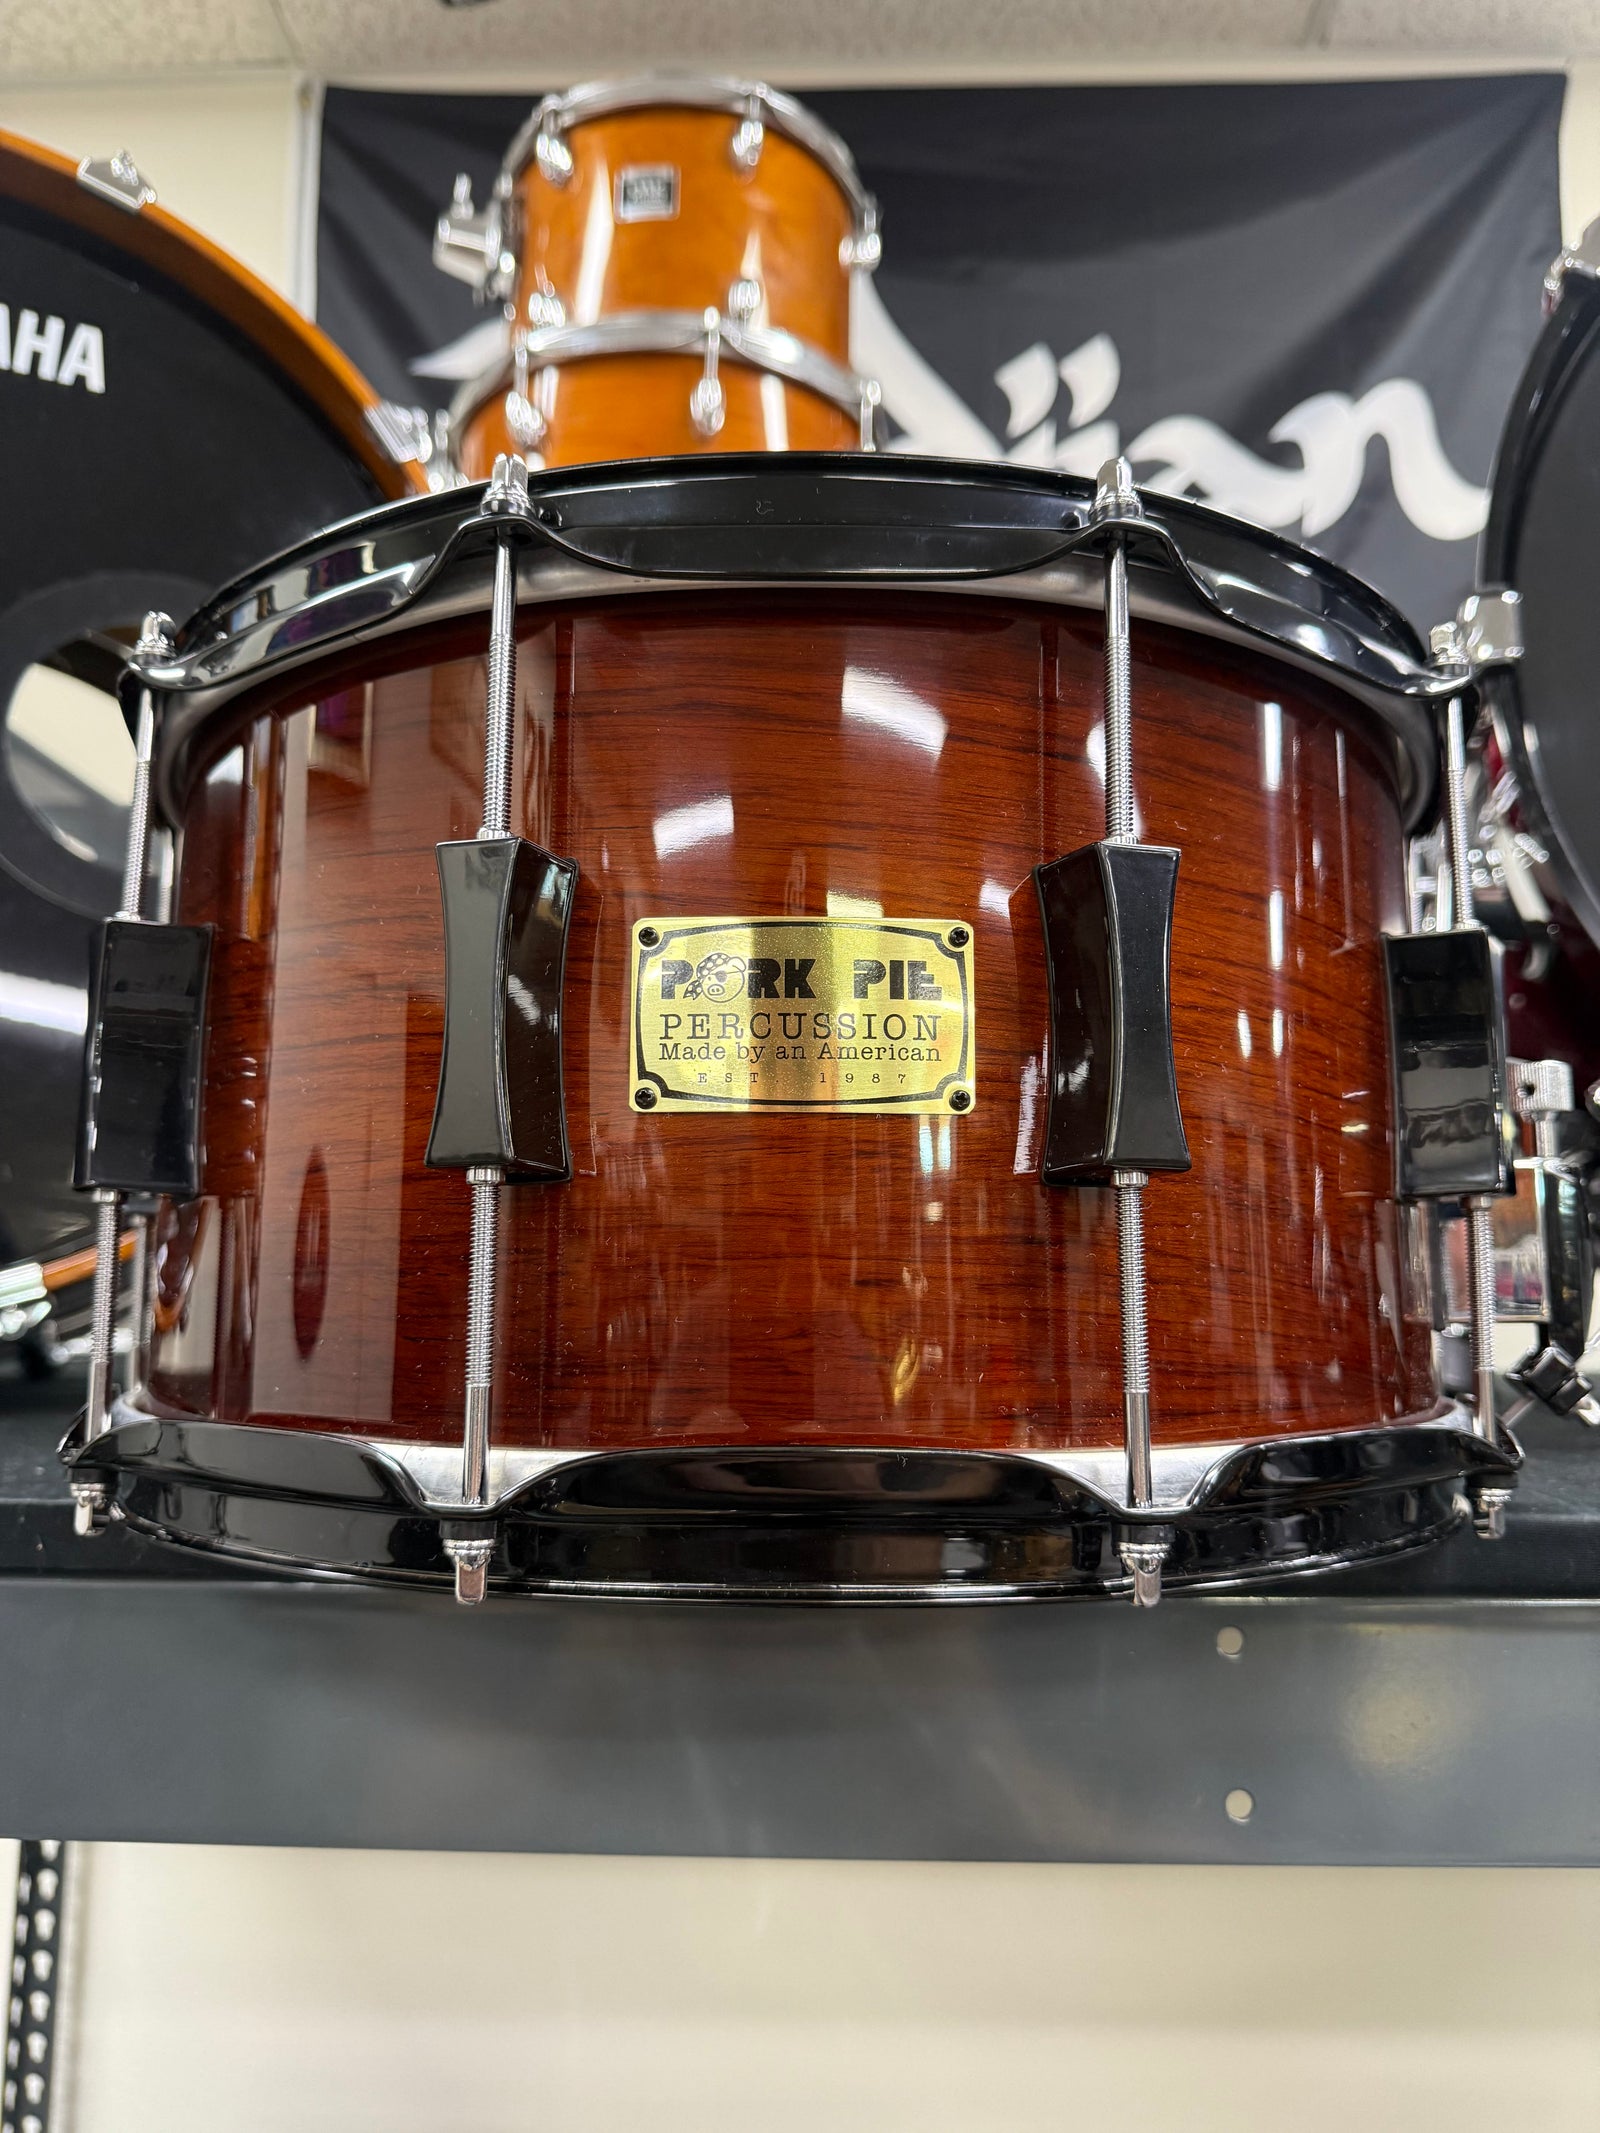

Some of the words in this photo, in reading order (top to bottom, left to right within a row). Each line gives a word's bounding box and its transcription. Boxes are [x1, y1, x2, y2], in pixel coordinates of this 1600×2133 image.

[0, 302, 106, 395] HA
[853, 958, 943, 1001] PIE
[659, 1011, 942, 1041] PERCUSSION
[658, 1042, 726, 1061] Made
[735, 1041, 766, 1064] by
[775, 1044, 807, 1060] an
[817, 1041, 942, 1062] American
[697, 1072, 779, 1083] EST.
[819, 1072, 906, 1084] 1987
